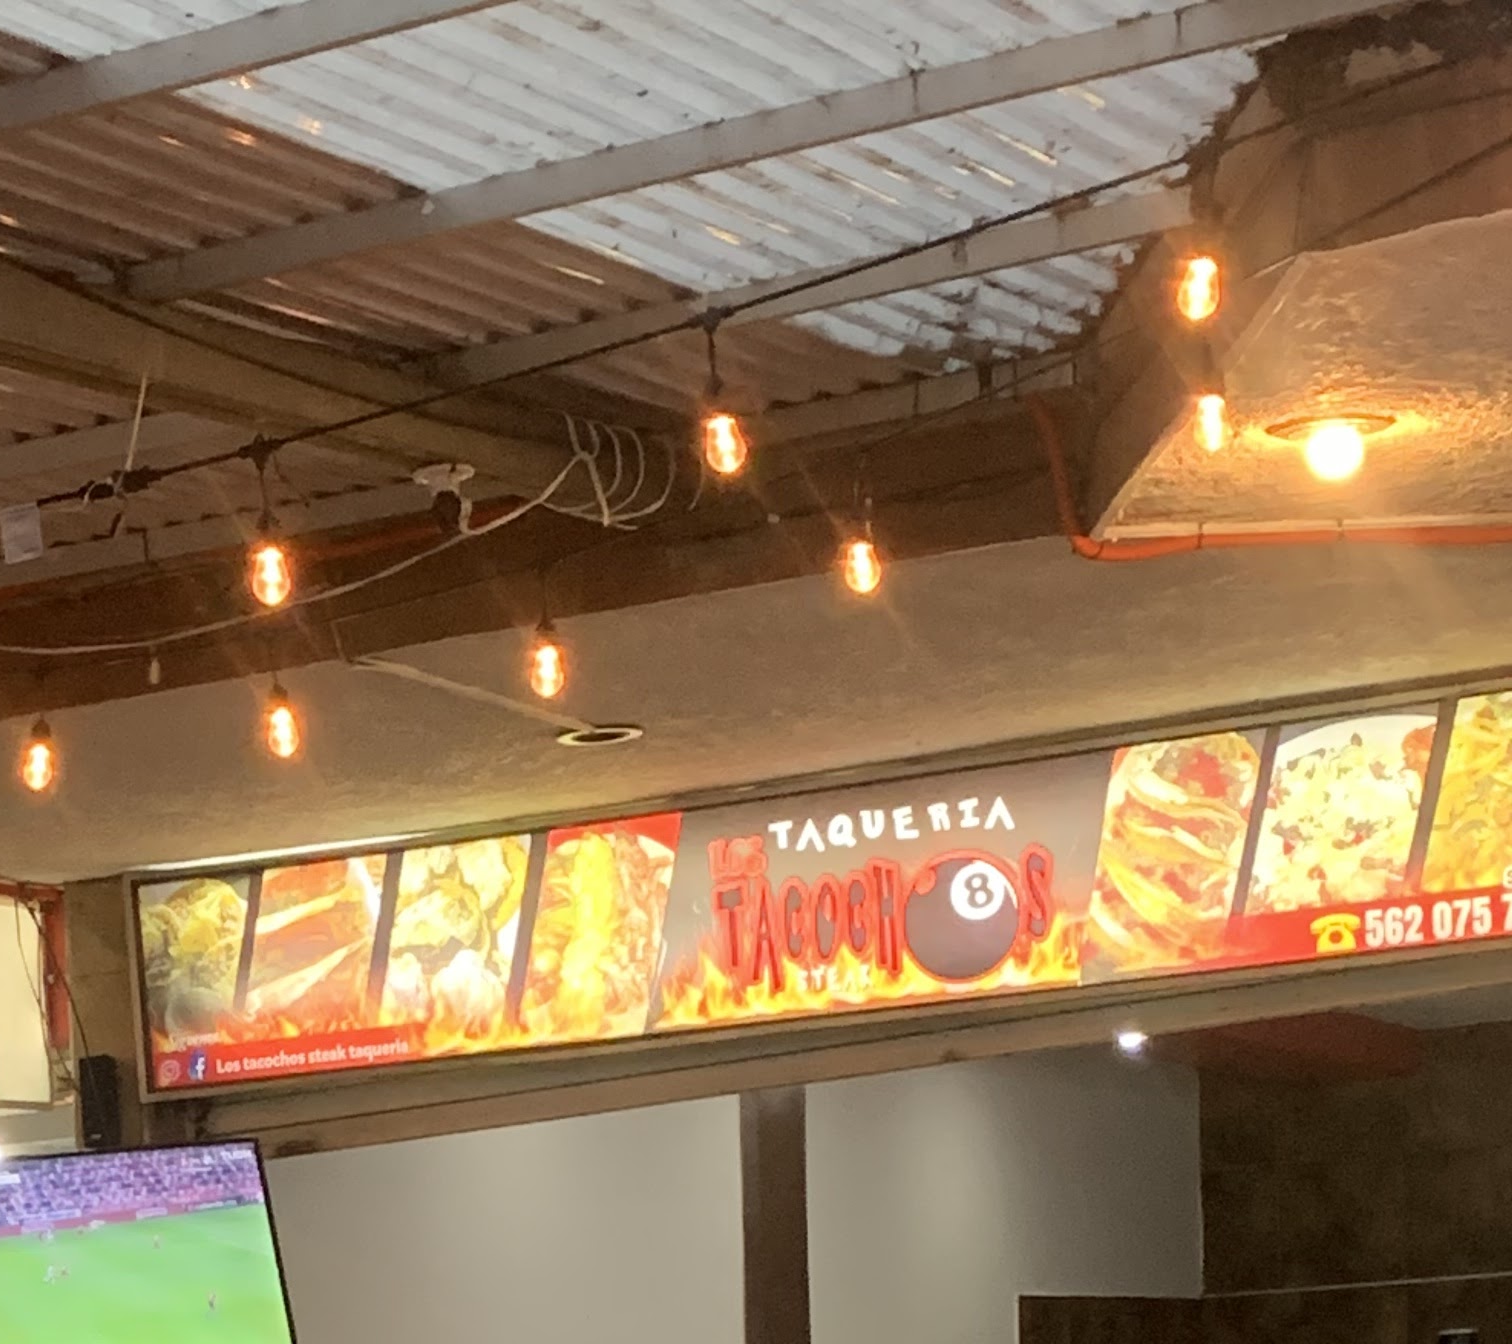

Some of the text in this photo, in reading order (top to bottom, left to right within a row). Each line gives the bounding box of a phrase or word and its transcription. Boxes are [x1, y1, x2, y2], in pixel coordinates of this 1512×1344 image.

[768, 796, 1016, 853] TAQUERIA
[707, 834, 768, 880] LOS
[961, 872, 995, 909] 8
[1364, 904, 1424, 949] 562
[1431, 895, 1493, 941] 075
[215, 1058, 241, 1074] Los
[243, 1049, 306, 1071] tacochos
[308, 1043, 347, 1064] steak
